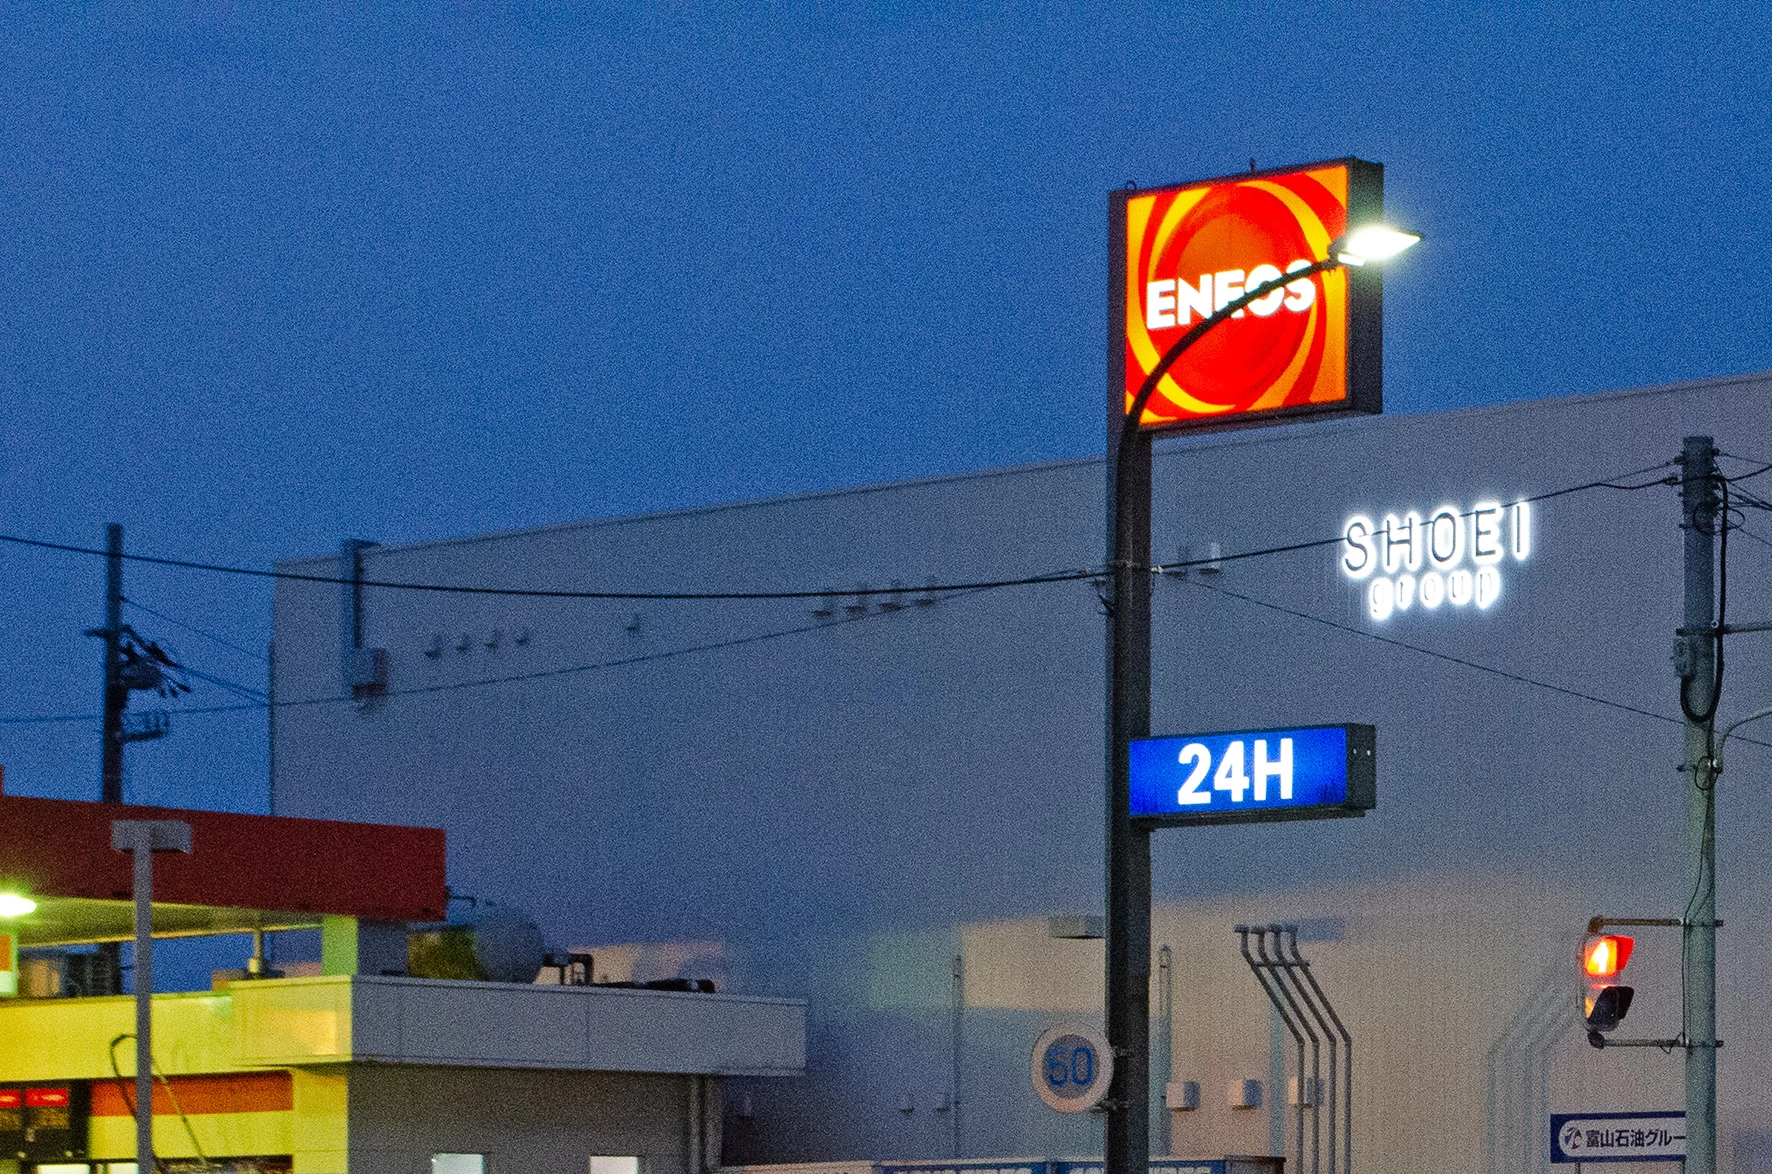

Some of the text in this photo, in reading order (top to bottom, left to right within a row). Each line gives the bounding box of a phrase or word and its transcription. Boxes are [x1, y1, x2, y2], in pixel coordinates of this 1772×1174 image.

[1146, 259, 1317, 330] ENEOS
[1343, 503, 1524, 574] SHOEI
[1371, 570, 1496, 617] group
[1177, 736, 1295, 806] 24H
[1049, 1047, 1094, 1086] 50
[1585, 1128, 1687, 1149] 富山石油グルー
